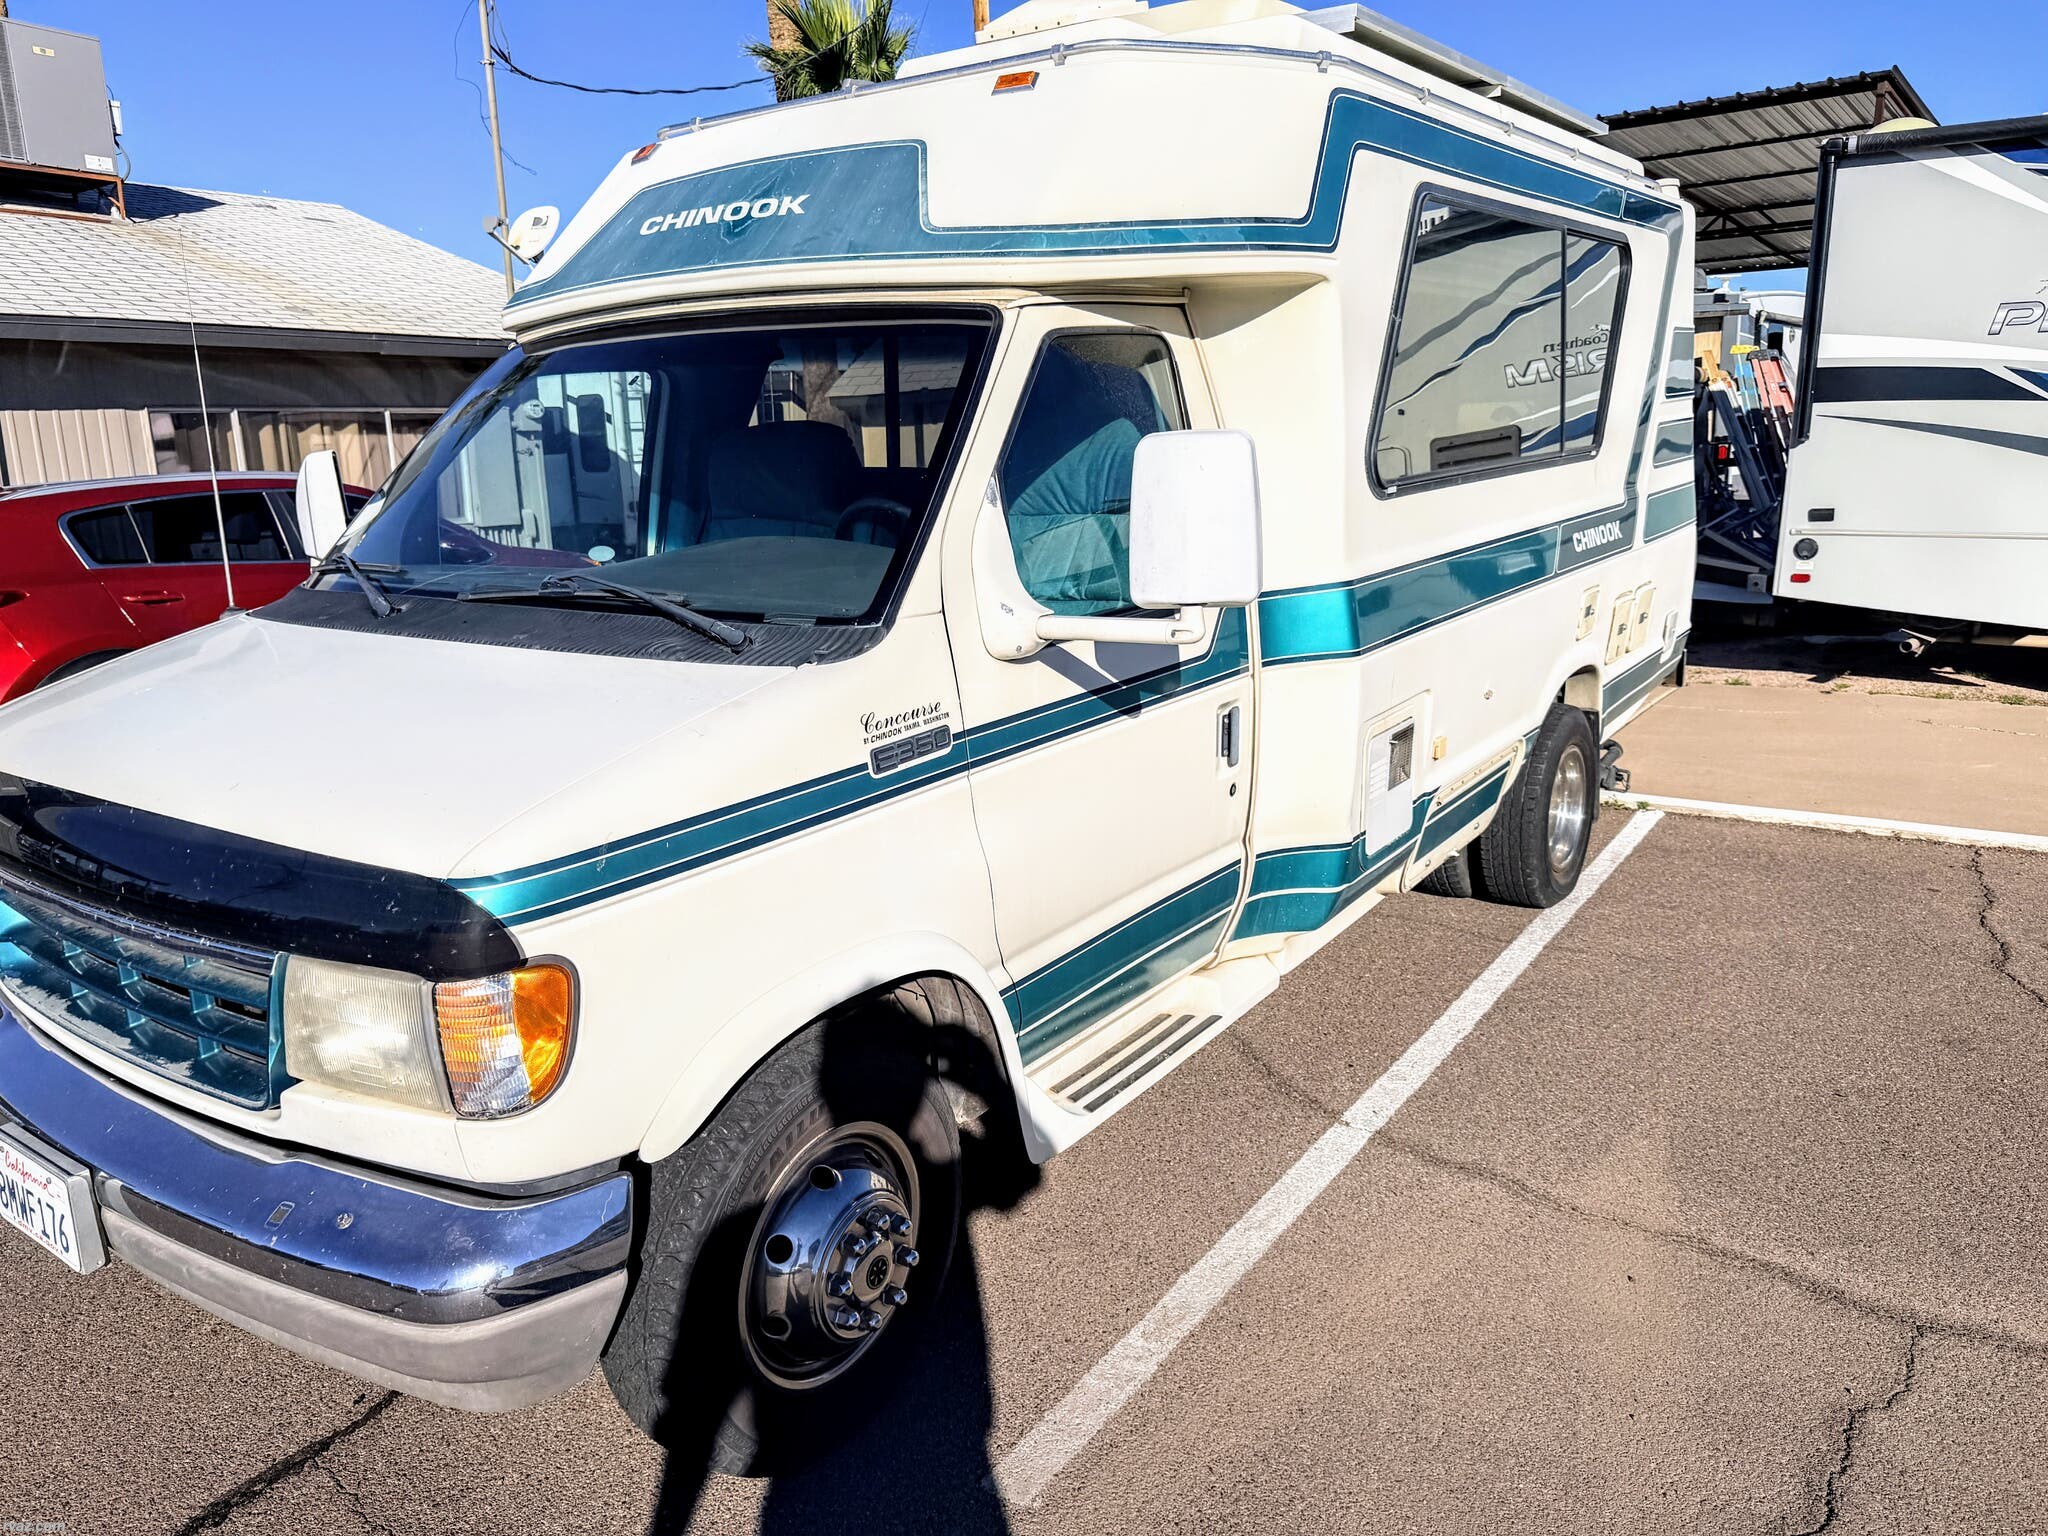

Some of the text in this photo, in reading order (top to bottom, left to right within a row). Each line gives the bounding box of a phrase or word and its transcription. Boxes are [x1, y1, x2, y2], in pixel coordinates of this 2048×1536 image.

[639, 194, 811, 236] CHINOOK
[1987, 300, 2048, 335] P
[1572, 520, 1623, 553] CHINOOK
[860, 701, 941, 735] Concourse
[870, 726, 903, 744] CHINOOK
[4, 1150, 54, 1198] California
